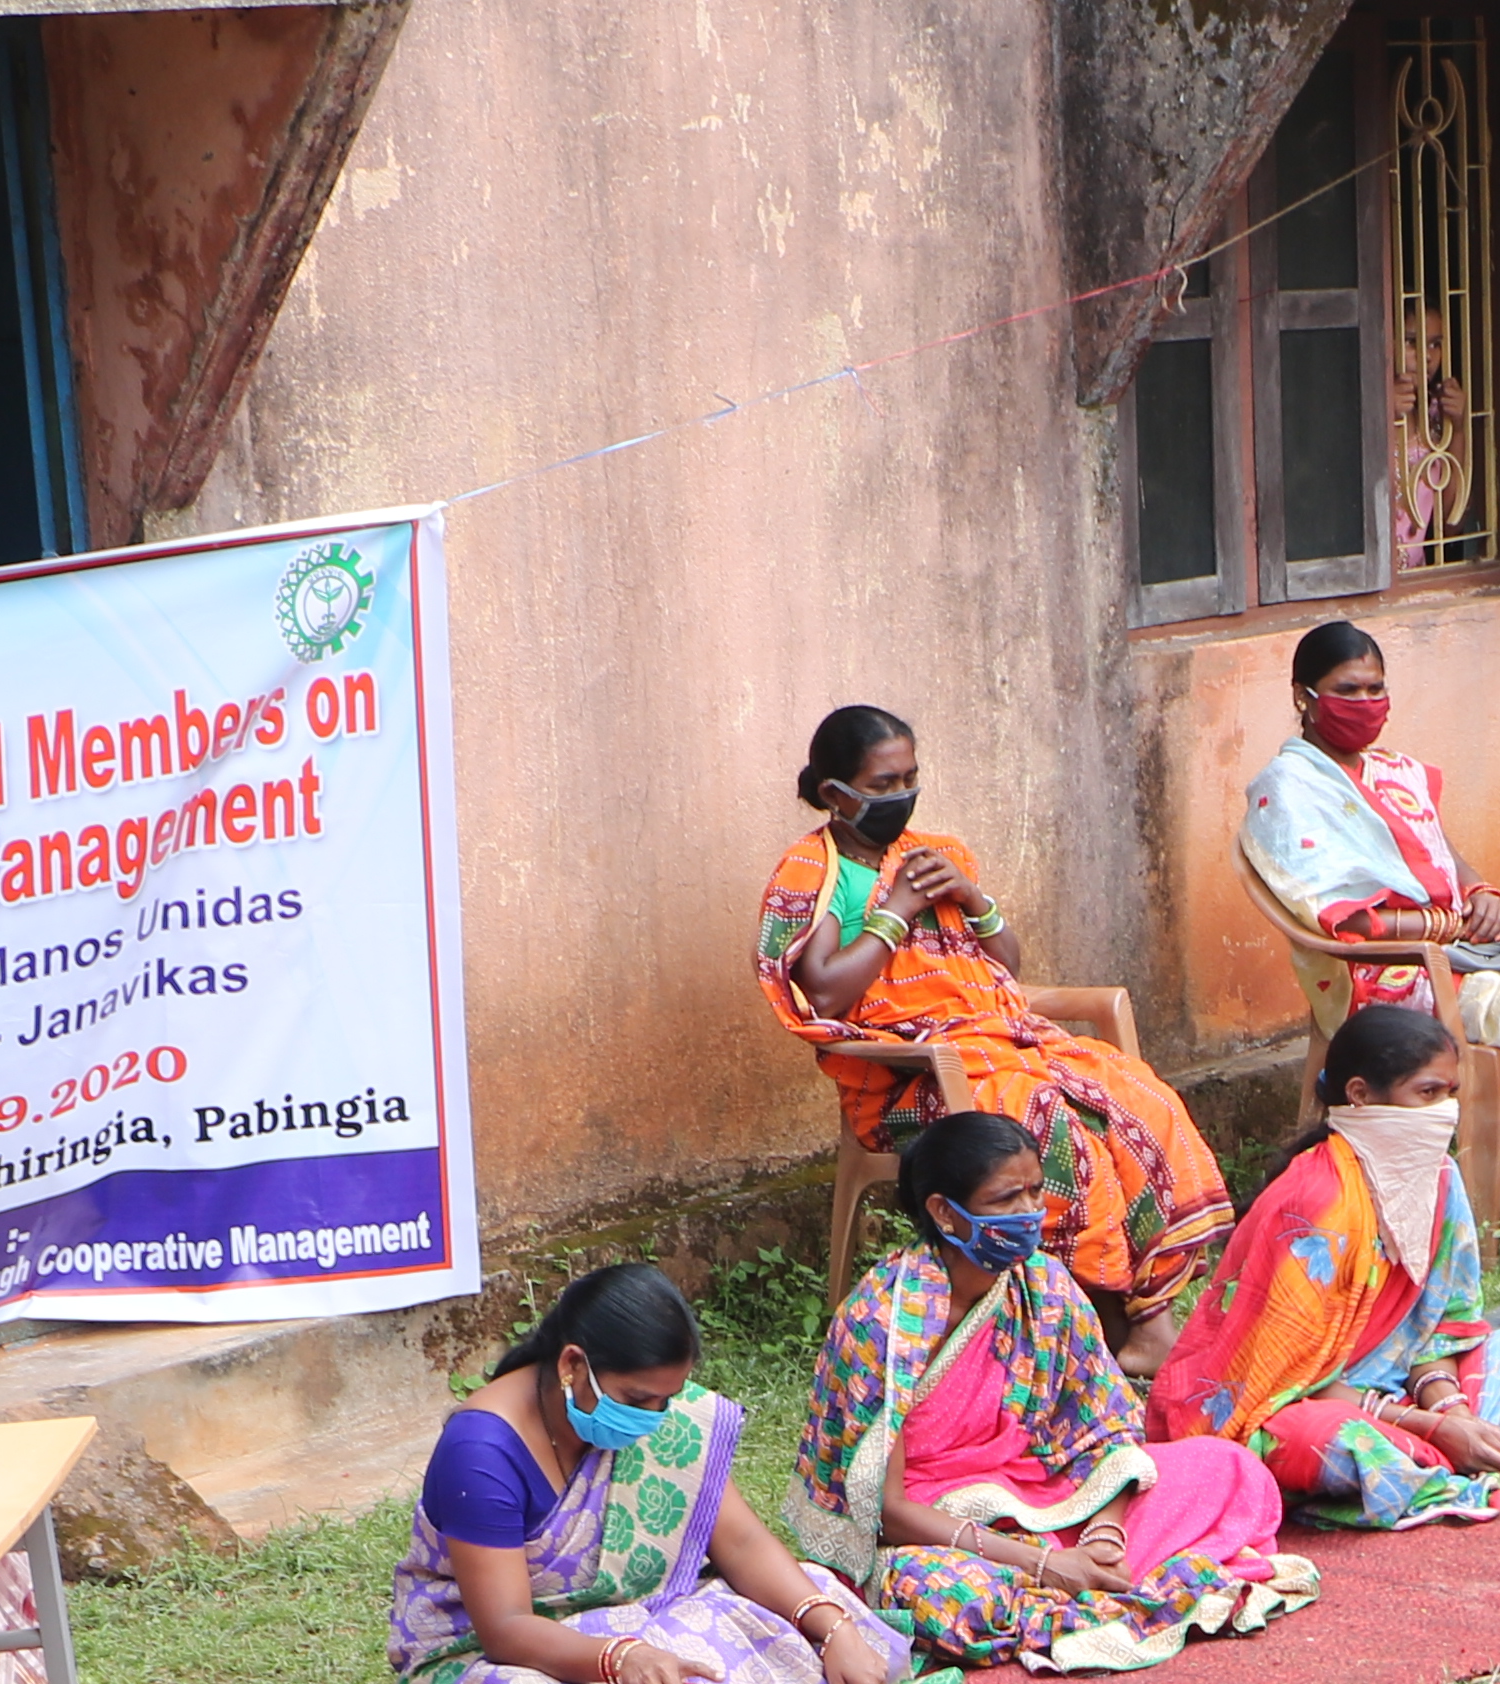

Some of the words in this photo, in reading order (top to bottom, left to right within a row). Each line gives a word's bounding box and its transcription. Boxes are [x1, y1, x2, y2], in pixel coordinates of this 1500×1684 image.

[27, 687, 286, 799] Members
[306, 671, 376, 739] on
[137, 886, 303, 942] Unidas
[17, 957, 250, 1047] Janavikas
[193, 1087, 410, 1143] Pabingia
[37, 1231, 223, 1282] Cooperative
[230, 1210, 432, 1269] Management
